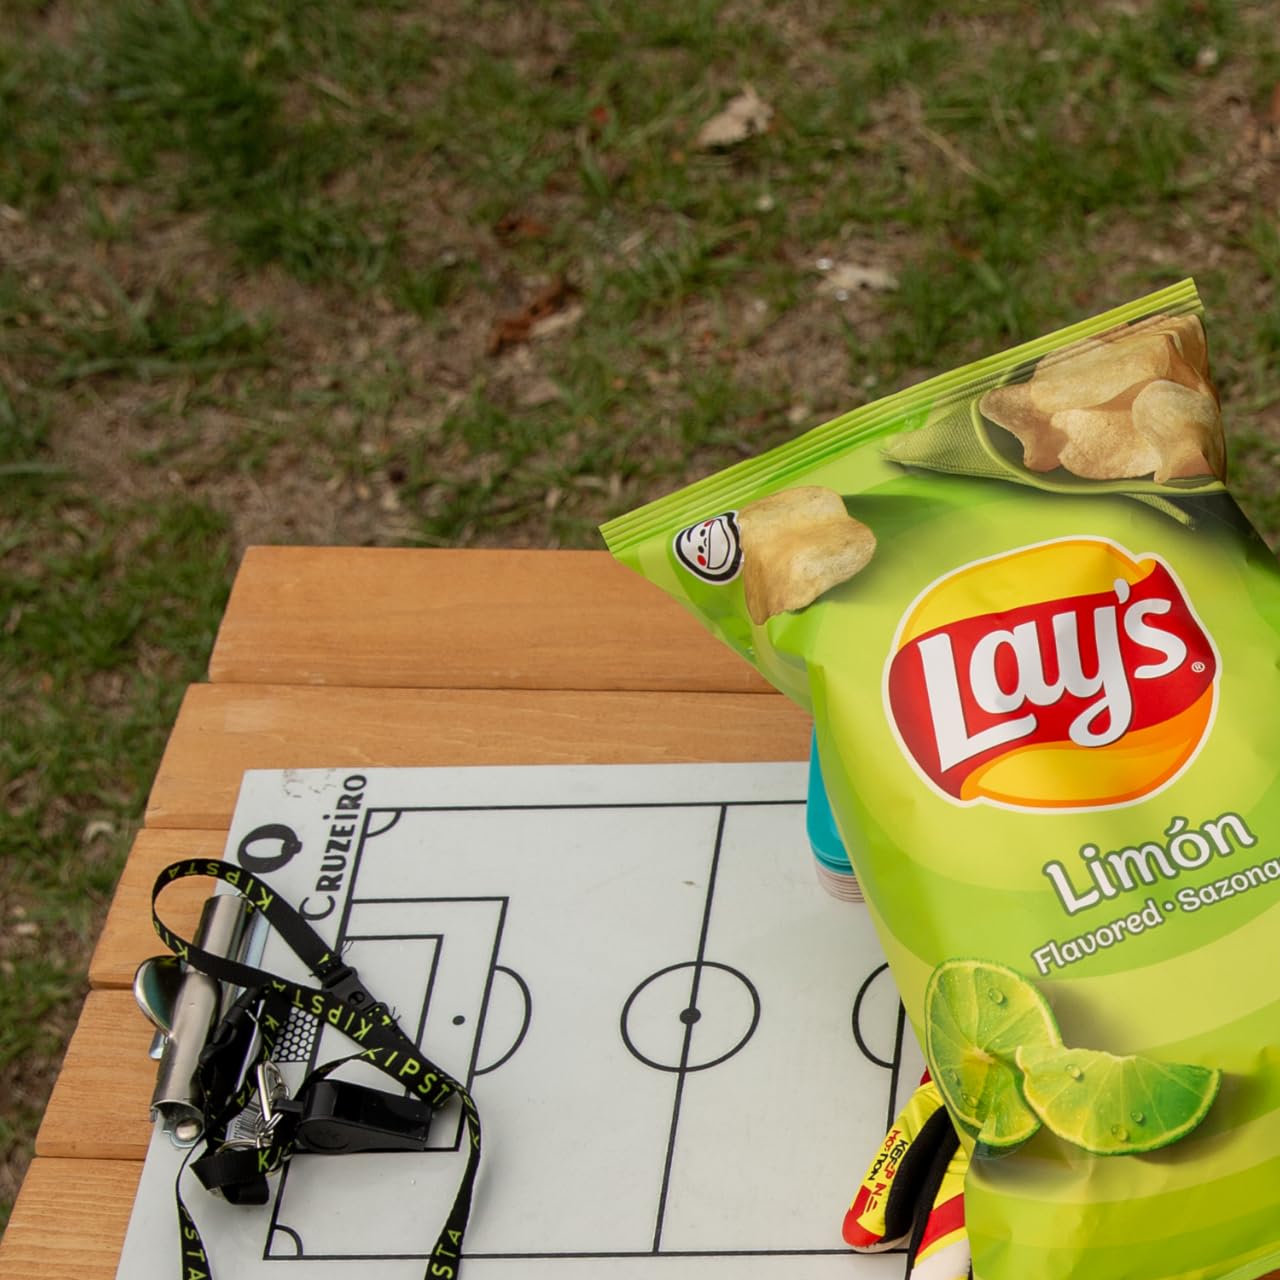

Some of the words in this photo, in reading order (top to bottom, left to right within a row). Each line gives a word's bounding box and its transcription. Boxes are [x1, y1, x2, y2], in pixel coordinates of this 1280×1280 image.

[916, 577, 1188, 774] Lay's
[167, 862, 274, 912] KIPSTA
[1043, 811, 1258, 916] Limón
[1031, 897, 1164, 976] Flavored
